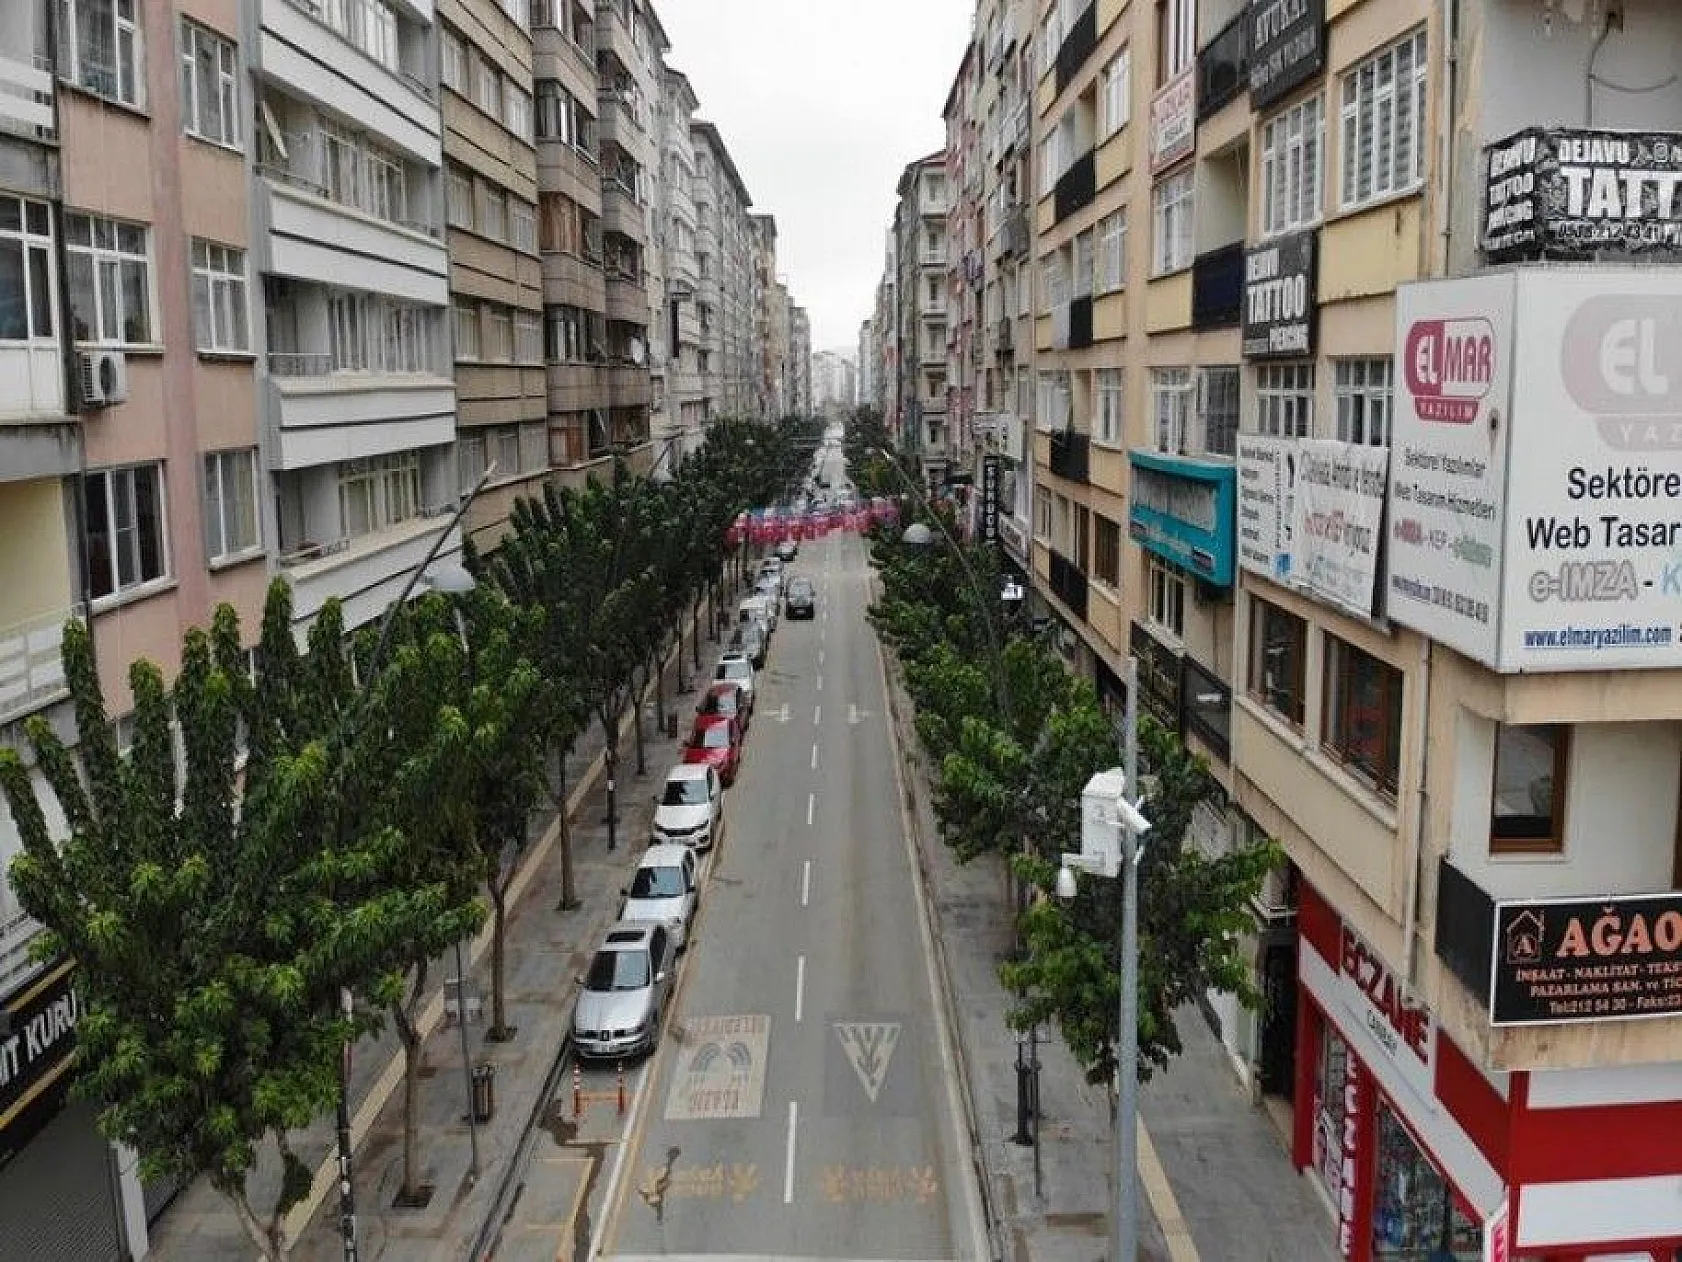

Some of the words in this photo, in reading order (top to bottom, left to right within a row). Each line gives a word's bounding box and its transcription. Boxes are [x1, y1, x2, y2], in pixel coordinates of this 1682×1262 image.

[1558, 139, 1630, 163] DEJAVU
[1560, 165, 1682, 219] TATT
[1248, 274, 1305, 325] TATTOO
[1416, 335, 1491, 384] ELMAR
[1602, 319, 1668, 395] EL
[1567, 466, 1681, 500] Sektöre
[1526, 515, 1591, 550] Web
[1599, 514, 1682, 549] Tasar
[1524, 624, 1672, 649] www.elmaryazilim.com
[1556, 906, 1682, 957] AĞAO
[1342, 925, 1429, 1066] ECZANE
